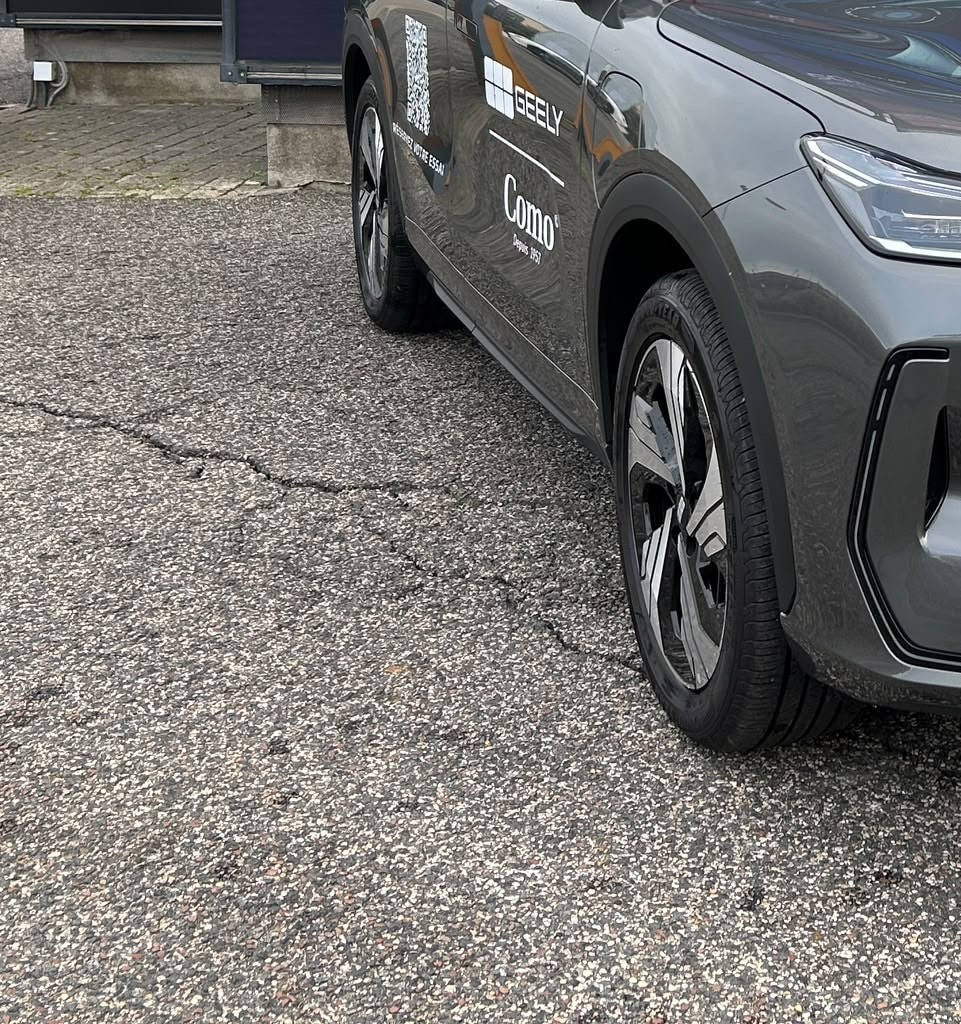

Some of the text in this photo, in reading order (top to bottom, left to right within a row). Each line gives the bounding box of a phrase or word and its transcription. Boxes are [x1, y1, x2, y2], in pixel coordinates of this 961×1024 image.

[514, 85, 564, 137] GEELY
[413, 140, 429, 164] VOTRE
[428, 154, 445, 176] ESSAI
[503, 173, 556, 251] Como
